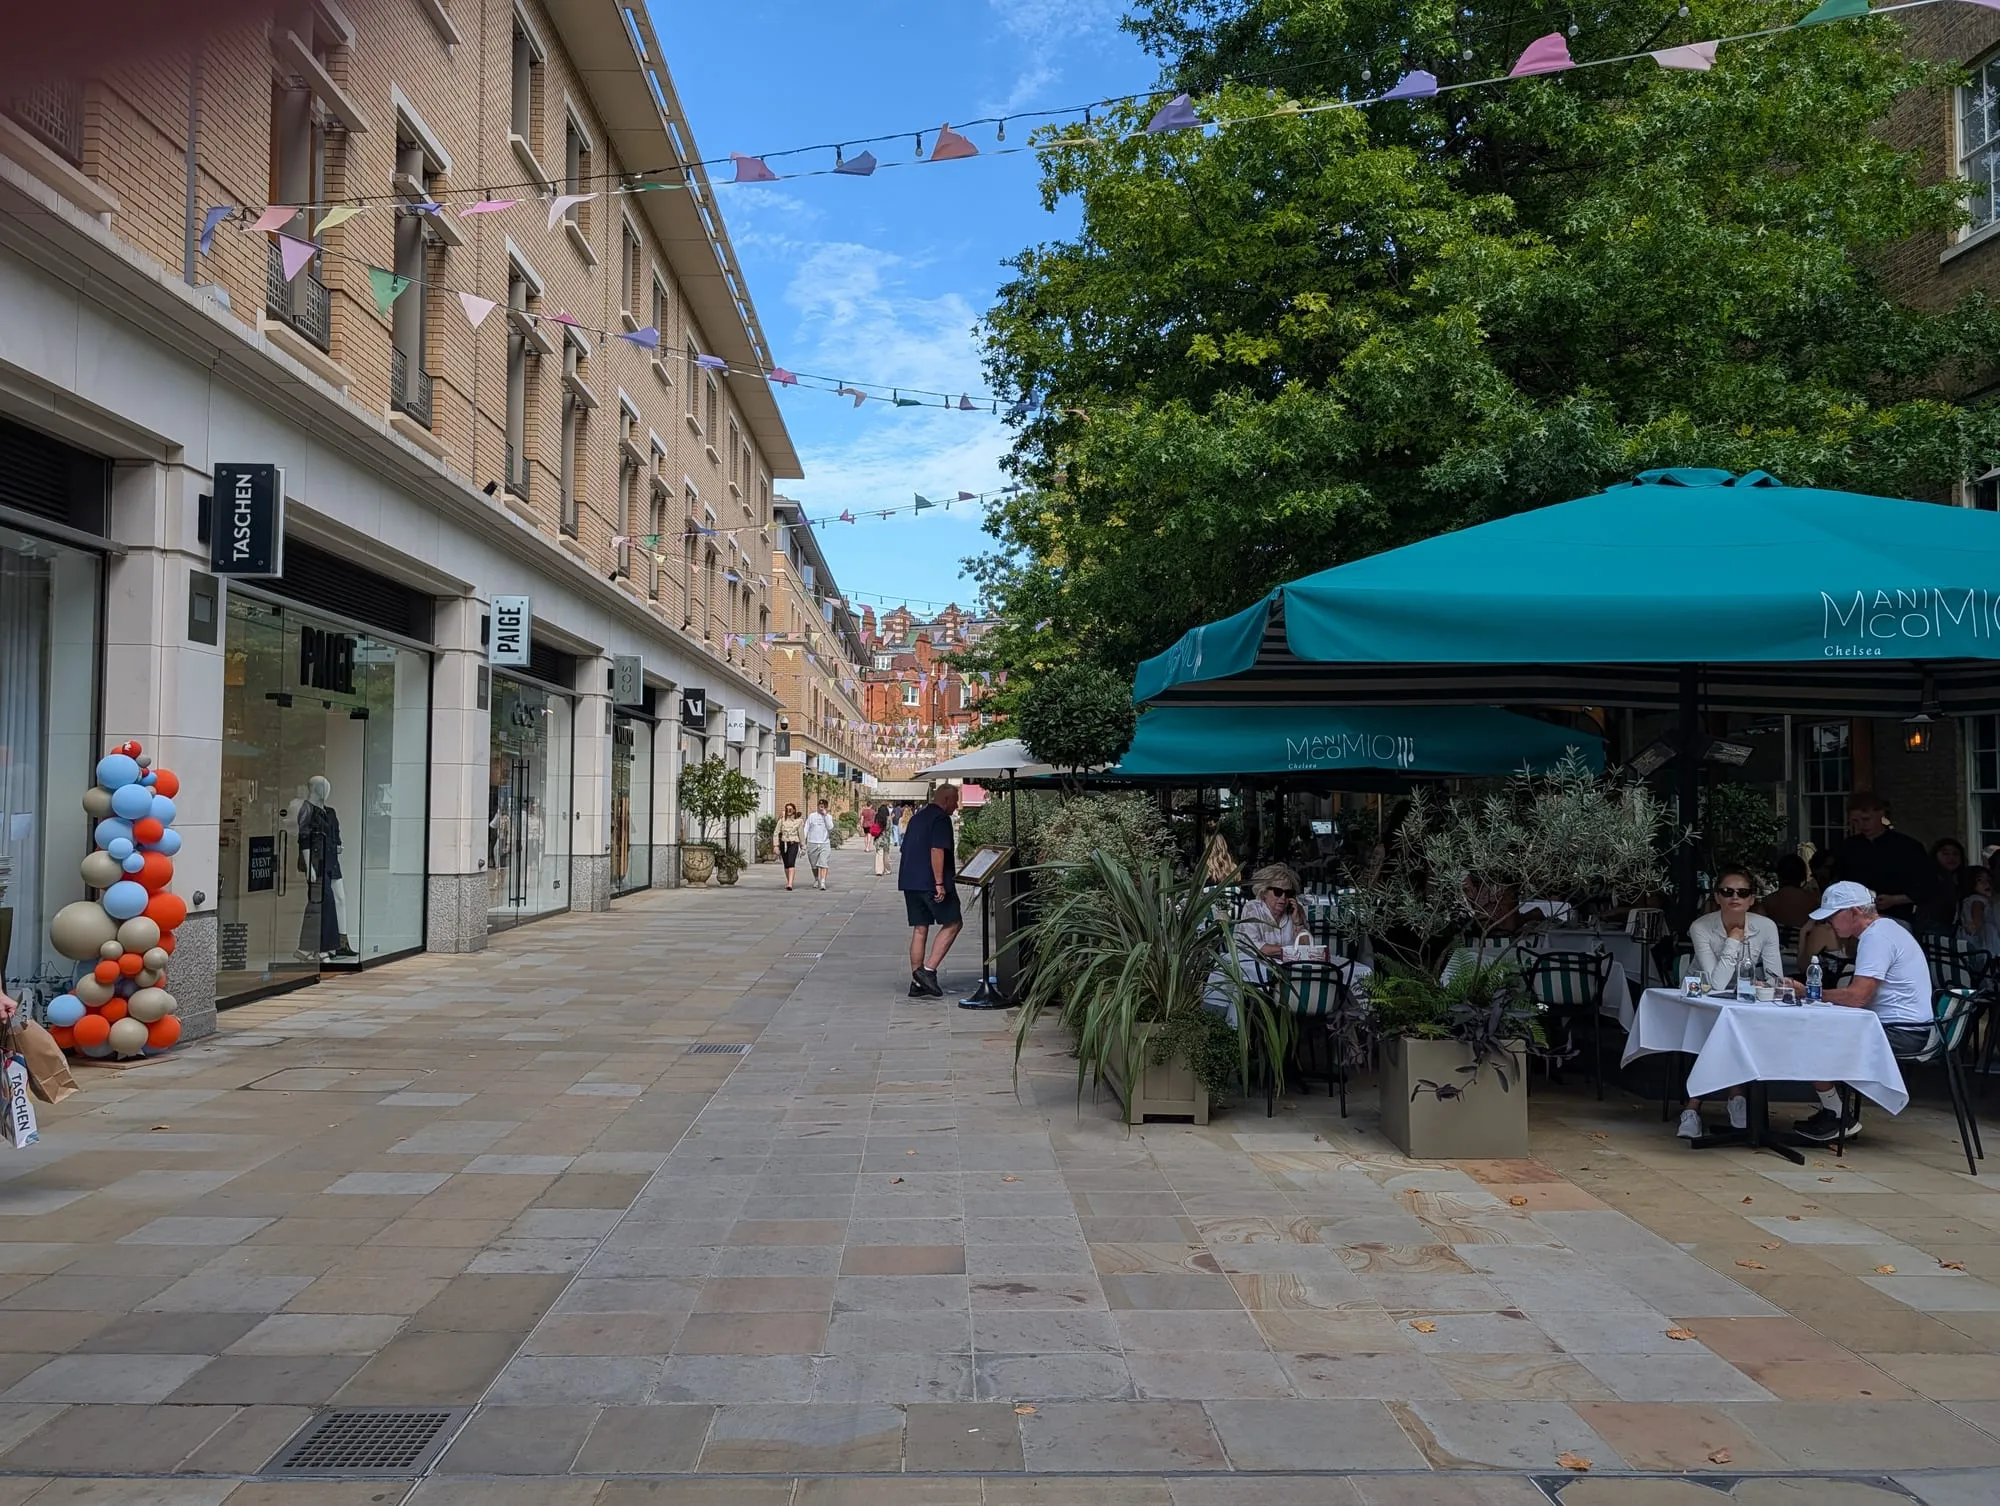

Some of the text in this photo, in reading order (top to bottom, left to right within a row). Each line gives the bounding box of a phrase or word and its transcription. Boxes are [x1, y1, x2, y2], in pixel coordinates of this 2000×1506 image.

[233, 474, 253, 562] TASCHEN
[497, 606, 521, 653] PAIGE
[1824, 645, 1882, 656] Chelsea
[621, 665, 632, 694] COS
[251, 857, 271, 868] EVENT
[251, 868, 271, 880] TODAY
[12, 1072, 30, 1132] TASCHEN
